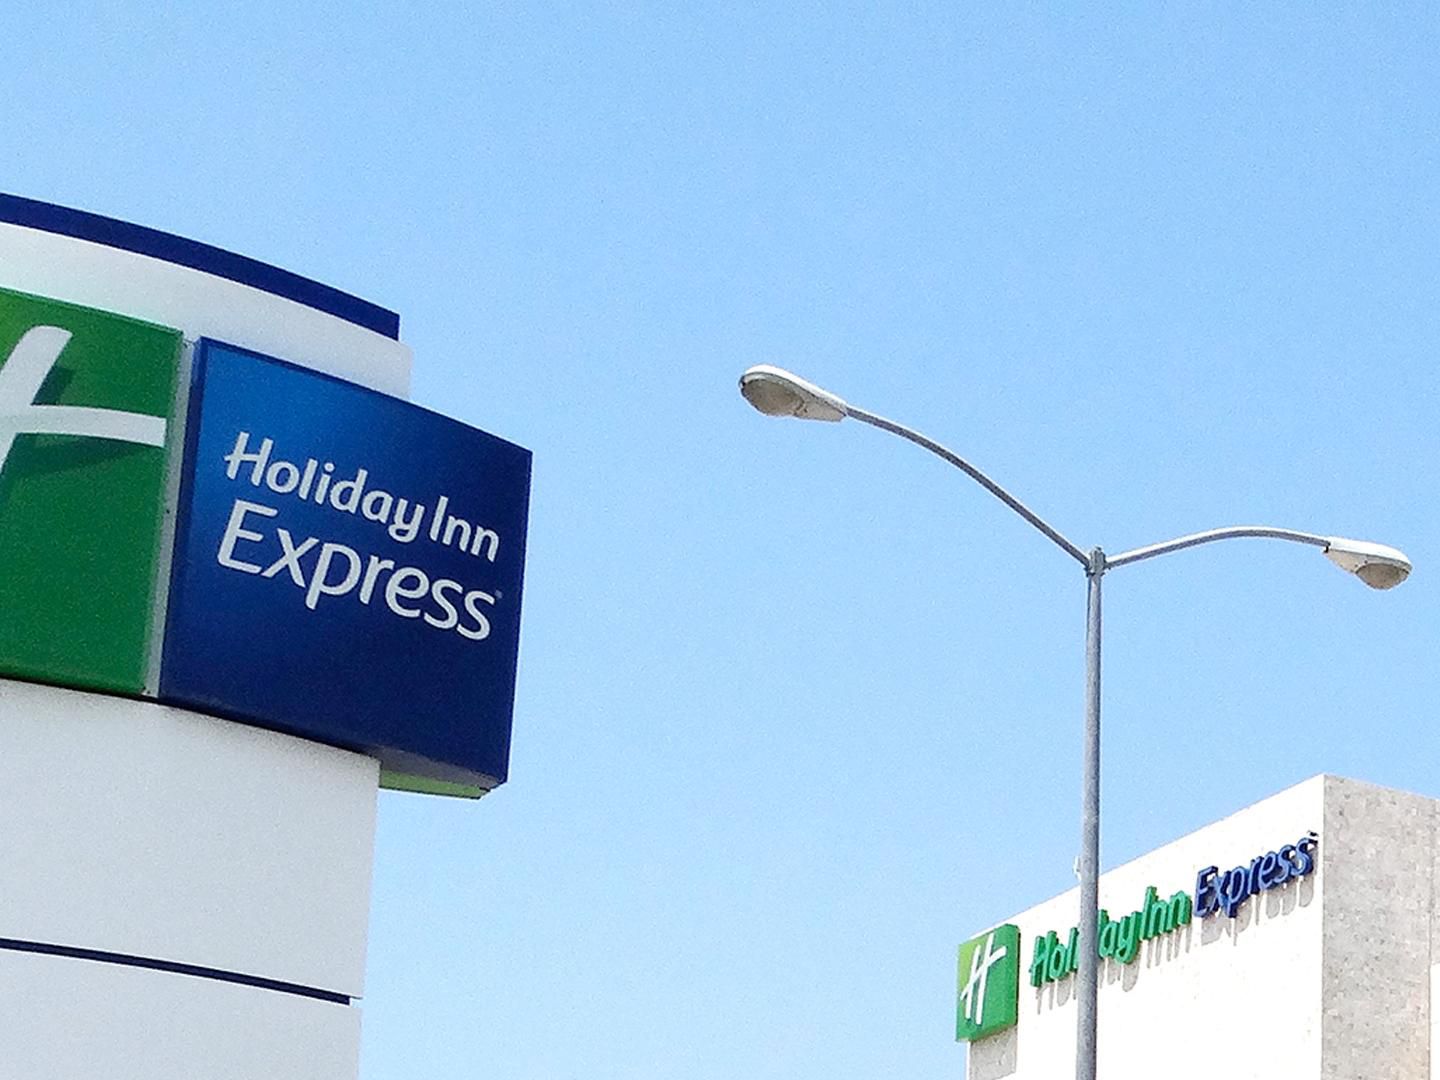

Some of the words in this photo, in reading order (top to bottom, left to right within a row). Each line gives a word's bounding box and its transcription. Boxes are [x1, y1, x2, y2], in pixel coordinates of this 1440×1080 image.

[224, 431, 425, 543] Holiday
[430, 495, 500, 563] Inn
[217, 499, 496, 641] Express
[1030, 910, 1141, 988] Holiay
[1140, 886, 1192, 940] Inn
[1193, 837, 1317, 918] Express
